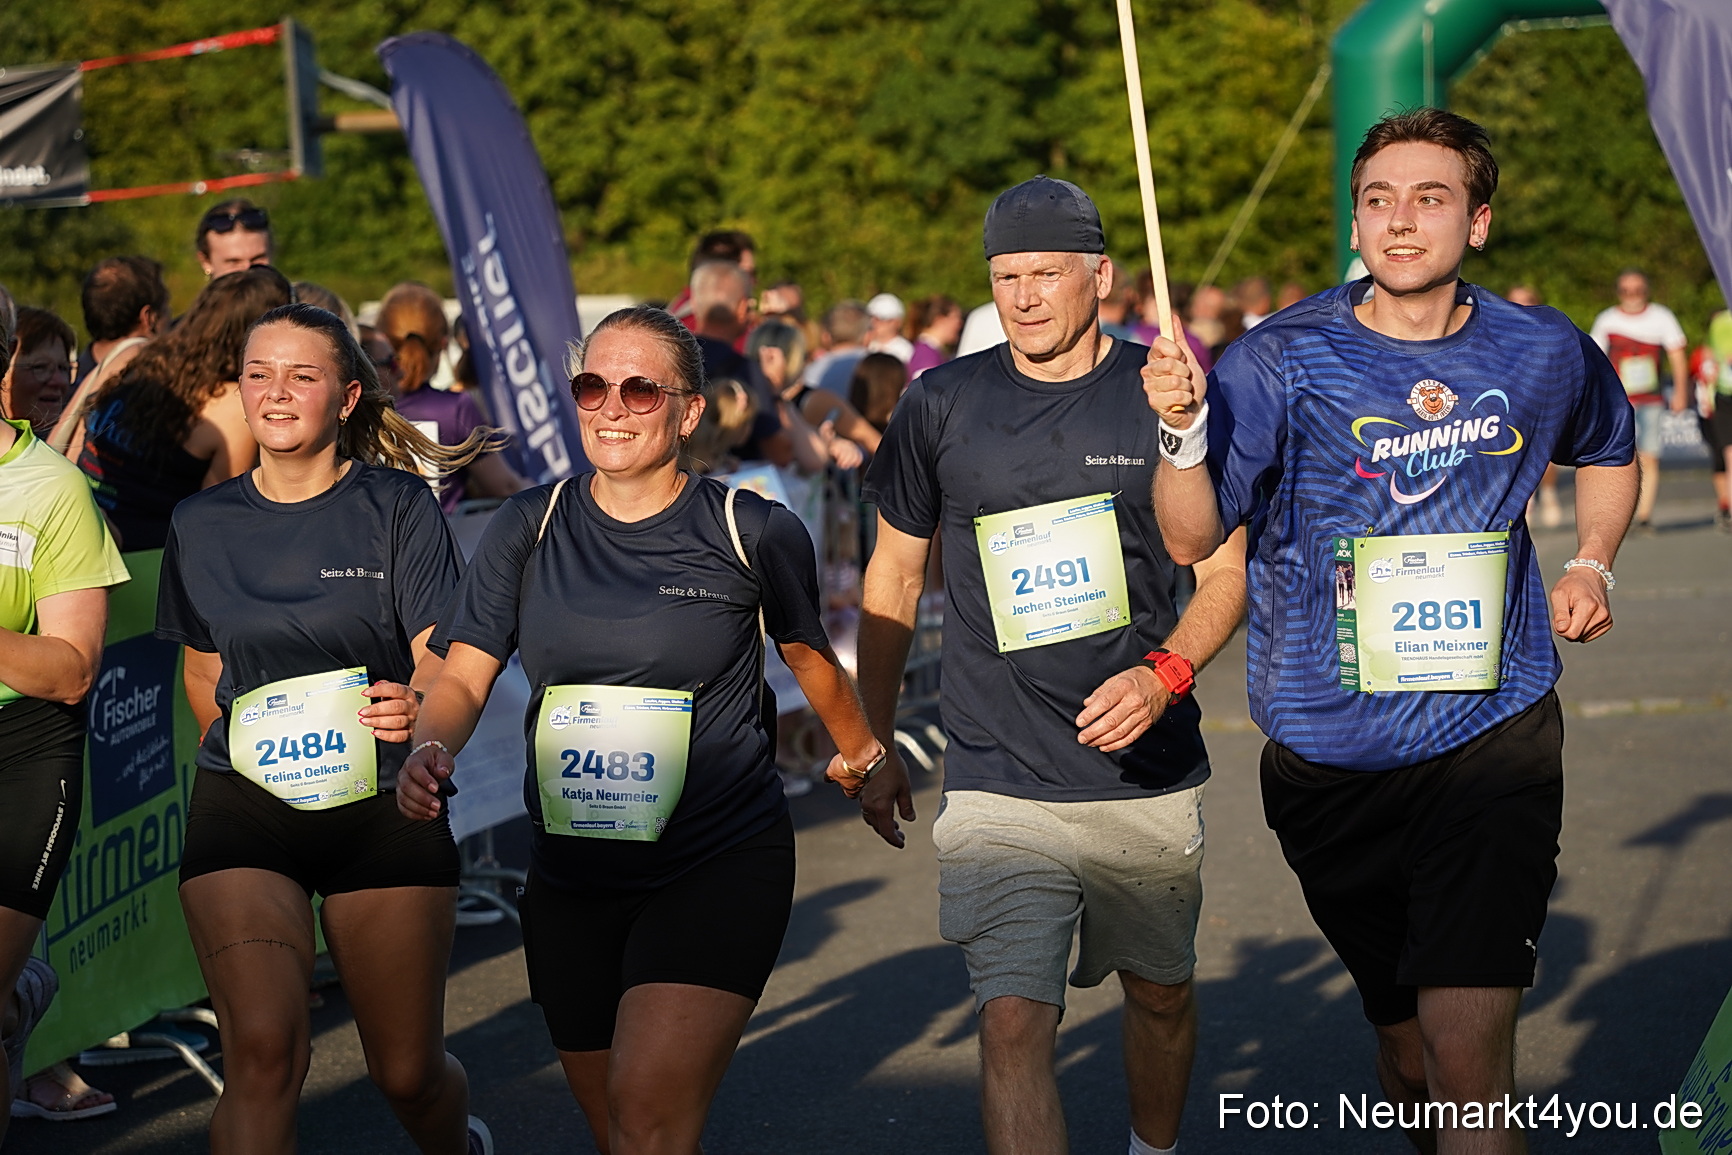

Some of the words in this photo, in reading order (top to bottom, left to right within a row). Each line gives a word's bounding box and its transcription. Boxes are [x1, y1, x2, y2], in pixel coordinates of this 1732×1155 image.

[1084, 454, 1108, 466] Seitz
[1108, 454, 1118, 464] &
[1117, 455, 1145, 466] Braun
[1406, 440, 1473, 478] Club
[1009, 530, 1051, 547] Firmenlauf
[1336, 549, 1352, 558] AOK
[320, 568, 344, 579] Seitz
[345, 567, 355, 577] &
[356, 567, 384, 579] Braun
[1011, 556, 1091, 596] 2491
[1395, 564, 1445, 577] Firmenlauf
[658, 585, 685, 597] Seitz
[686, 587, 697, 597] &
[699, 588, 731, 601] Braun
[1012, 601, 1052, 616] Jochen
[1054, 589, 1107, 608] Steinlein
[1391, 599, 1482, 632] 2861
[1394, 641, 1429, 653] Elian
[1433, 639, 1488, 653] Meixner
[103, 684, 161, 732] Fischer
[261, 703, 304, 718] Firmenlauf
[110, 713, 157, 747] AUTOMOBILE
[255, 729, 347, 767] 2484
[264, 769, 302, 783] Felina
[304, 763, 350, 781] Oelkers
[560, 748, 656, 782] 2483
[562, 788, 593, 803] Katja
[596, 788, 659, 803] Neumeier
[45, 806, 64, 852] SWOOSH
[41, 851, 50, 867] BY
[32, 864, 45, 891] NIKE
[70, 892, 148, 975] neumarkt
